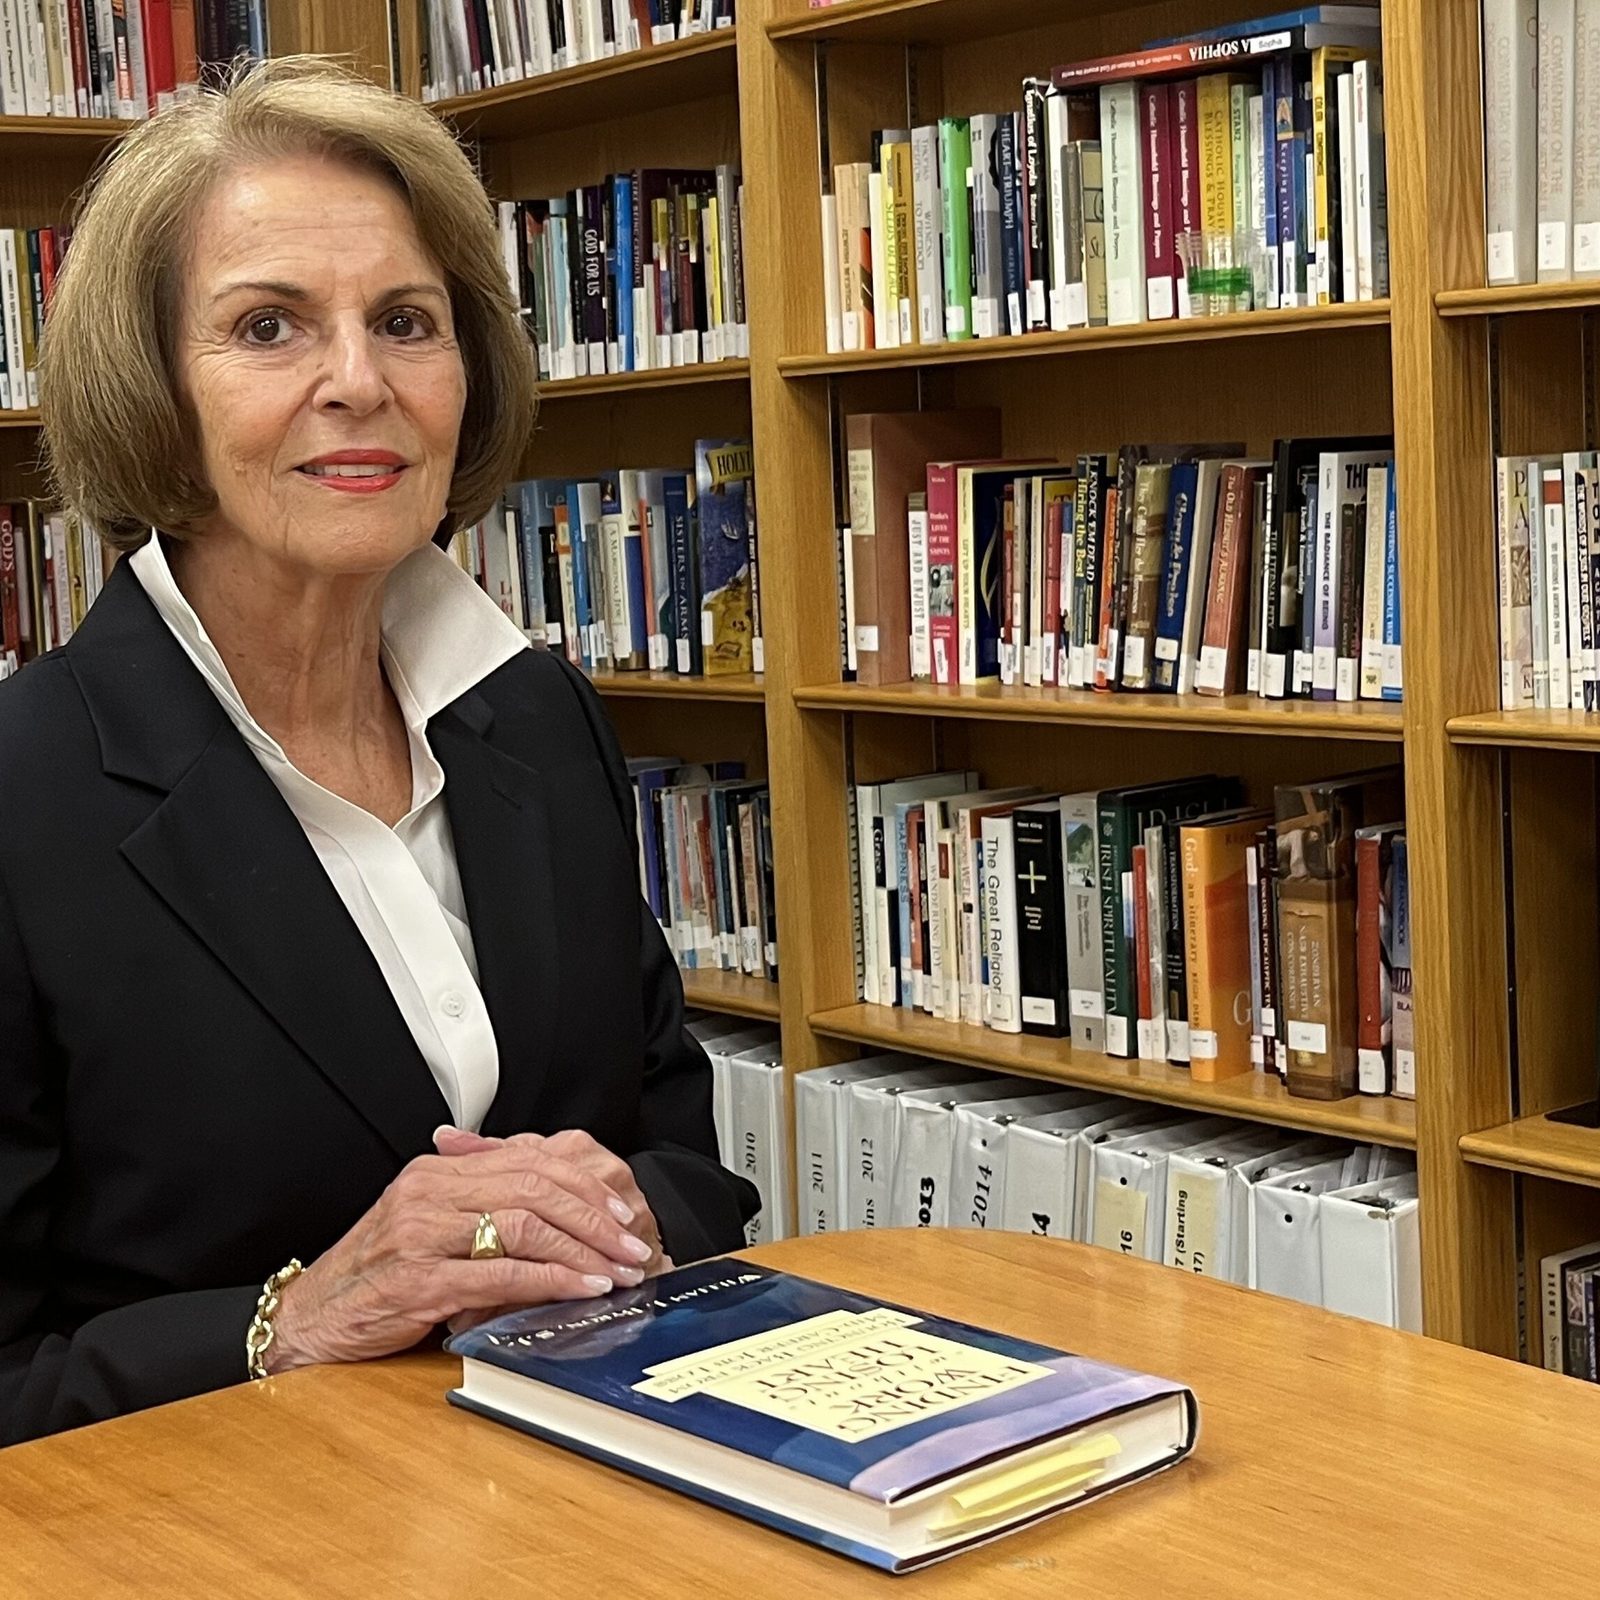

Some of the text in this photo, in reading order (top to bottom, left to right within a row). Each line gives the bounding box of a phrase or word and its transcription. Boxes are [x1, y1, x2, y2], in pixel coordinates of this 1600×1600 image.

[1189, 40, 1238, 61] SOPHIA
[1110, 99, 1118, 129] Catholic
[1233, 109, 1241, 142] STANZ
[1551, 35, 1563, 194] COMMENTARY ON THE
[1587, 28, 1599, 190] COMMENTARY ON THE
[1001, 127, 1011, 166] HEART
[1025, 90, 1038, 186] Ignatius of Loyola
[1111, 133, 1119, 173] Household
[1148, 95, 1162, 258] Catholic Household Blessings and Prayers
[1204, 112, 1215, 228] BLESSINGS & PRAY
[1280, 142, 1290, 219] Keeping the
[916, 202, 923, 218] TO
[1002, 174, 1015, 229] TRIUMPH
[1111, 176, 1119, 212] Blessings
[924, 211, 933, 258] WITNESS
[1112, 233, 1120, 260] Prayers
[584, 229, 600, 296] GOD FOR US
[1074, 478, 1086, 521] Hiring
[1087, 471, 1097, 517] KNOCK
[1137, 482, 1149, 502] They
[1225, 492, 1235, 512] OLD
[1306, 499, 1314, 527] Naming
[1, 520, 14, 572] GOD'S
[749, 538, 757, 560] FIRST
[1076, 524, 1086, 546] the
[1322, 532, 1331, 581] RADIANCE
[1387, 510, 1396, 563] MASTERING
[1499, 527, 1507, 548] JEWS
[609, 538, 620, 595] MARGINAL
[675, 516, 689, 639] SISTERS IN ARMS
[750, 562, 758, 591] URBAN
[911, 519, 924, 619] JUST AND UNJUST
[963, 559, 970, 570] UP
[1075, 548, 1086, 577] Best
[1086, 545, 1095, 581] DEAD
[1134, 559, 1143, 572] the
[1215, 560, 1228, 604] ALMANAC
[1576, 485, 1591, 642] THE WORDS OF JESUS IN OUR GOSPELS
[613, 598, 622, 619] JEW
[1131, 574, 1143, 614] Baroness
[1322, 585, 1330, 597] OF
[1387, 565, 1396, 621] SUCCESSFUL
[1500, 568, 1508, 608] GENTILES
[751, 592, 759, 637] CHRISTIAN
[963, 597, 971, 629] HEARTS
[1321, 600, 1329, 630] BEING
[873, 829, 884, 874] Grace
[898, 822, 909, 904] HAPPINESS
[1170, 851, 1180, 930] TRANSFORMATION
[1184, 838, 1198, 963] God: an itinerary
[930, 864, 941, 969] WANDERING JOY
[986, 837, 1002, 994] The Great Religion
[1076, 894, 1086, 957] Bible Commentary
[1100, 843, 1117, 1015] IRISH SPIRITUALITY
[1397, 886, 1406, 947] HANDBOOK
[1286, 931, 1297, 1010] CONCORDANCE
[1310, 940, 1321, 1008] ZONDERVAN
[745, 1131, 756, 1175] 2010
[812, 1152, 824, 1193] 2011
[861, 1137, 874, 1182] 2012
[971, 1165, 992, 1228] 2014
[1175, 1190, 1189, 1257] (Starting
[645, 1300, 667, 1308] J.
[670, 1273, 762, 1303] WILLIAM
[557, 1307, 644, 1330] BYRON,
[652, 1311, 889, 1389] MID-CAREER JOB LOSS
[667, 1317, 909, 1395] BOUNCING BACK FROM
[755, 1338, 905, 1392] HEART
[768, 1344, 937, 1403] LOSING
[828, 1367, 976, 1414] WORK
[836, 1365, 1028, 1434] FINDING
